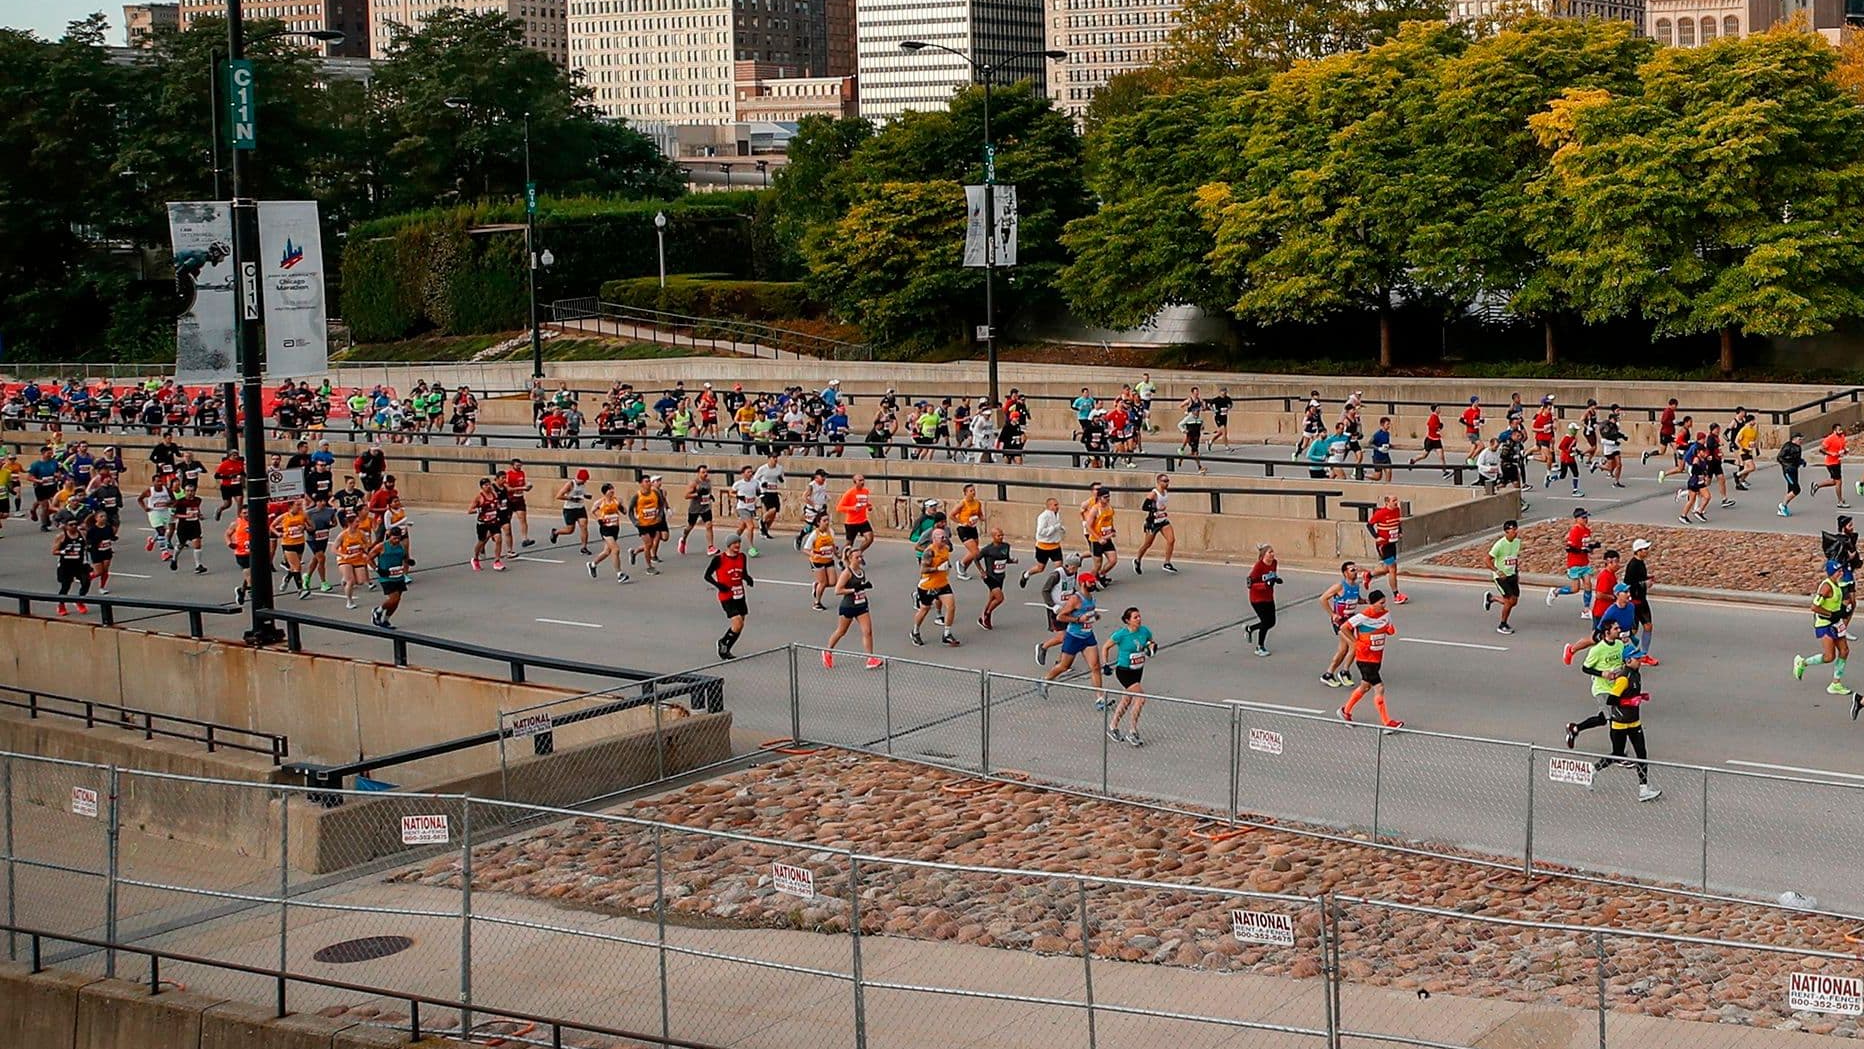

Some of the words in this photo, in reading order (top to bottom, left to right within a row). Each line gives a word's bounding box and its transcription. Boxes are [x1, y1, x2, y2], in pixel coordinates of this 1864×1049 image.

[234, 68, 254, 140] C11N
[244, 264, 259, 317] C11N
[513, 712, 551, 729] NATIONAL
[1550, 758, 1591, 773] NATIONAL
[403, 816, 446, 830] NATIONAL
[773, 863, 812, 883] NATIONAL
[1233, 911, 1291, 931] NATIONAL
[1791, 973, 1861, 997] NATIONAL
[1791, 990, 1861, 1004] RENT-A-FENCE
[1791, 997, 1861, 1011] 800-352-5675
